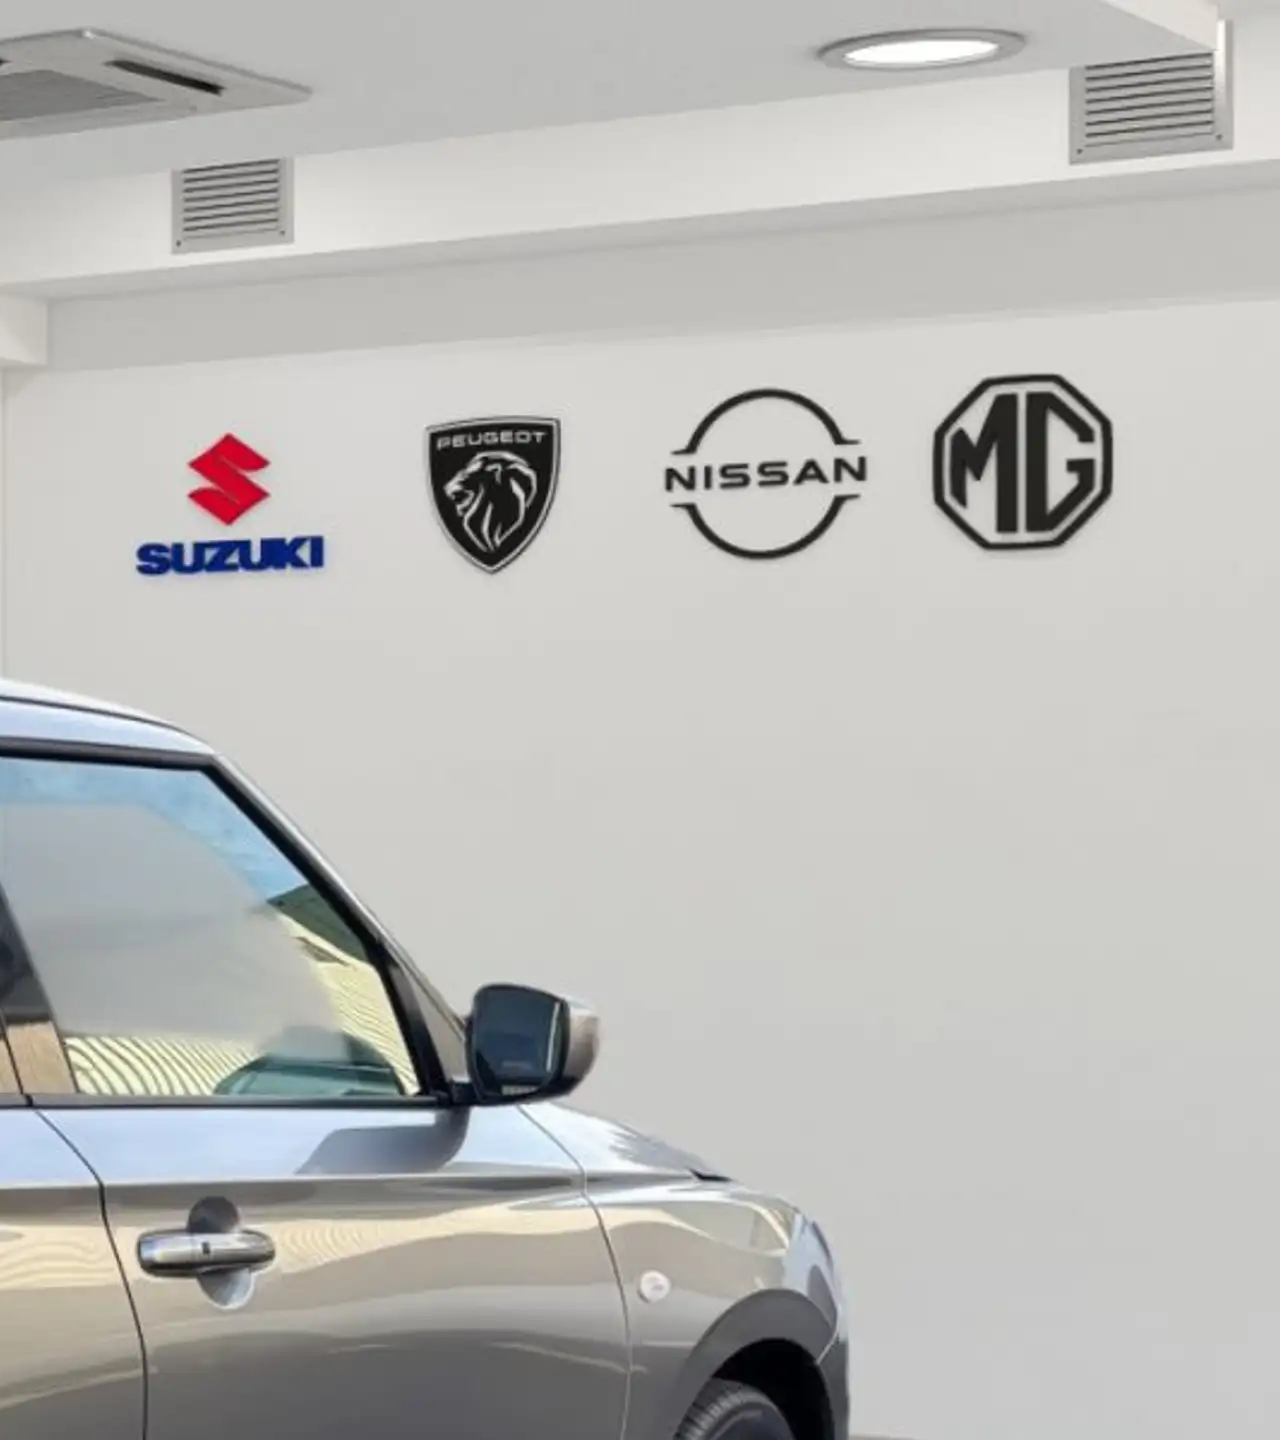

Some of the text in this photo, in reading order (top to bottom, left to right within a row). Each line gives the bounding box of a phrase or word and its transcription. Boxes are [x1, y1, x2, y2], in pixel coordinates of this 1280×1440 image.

[437, 430, 547, 450] PEUGEOT
[663, 456, 868, 494] NISSAN
[948, 390, 1097, 536] MG
[135, 535, 326, 576] SUZUKI
